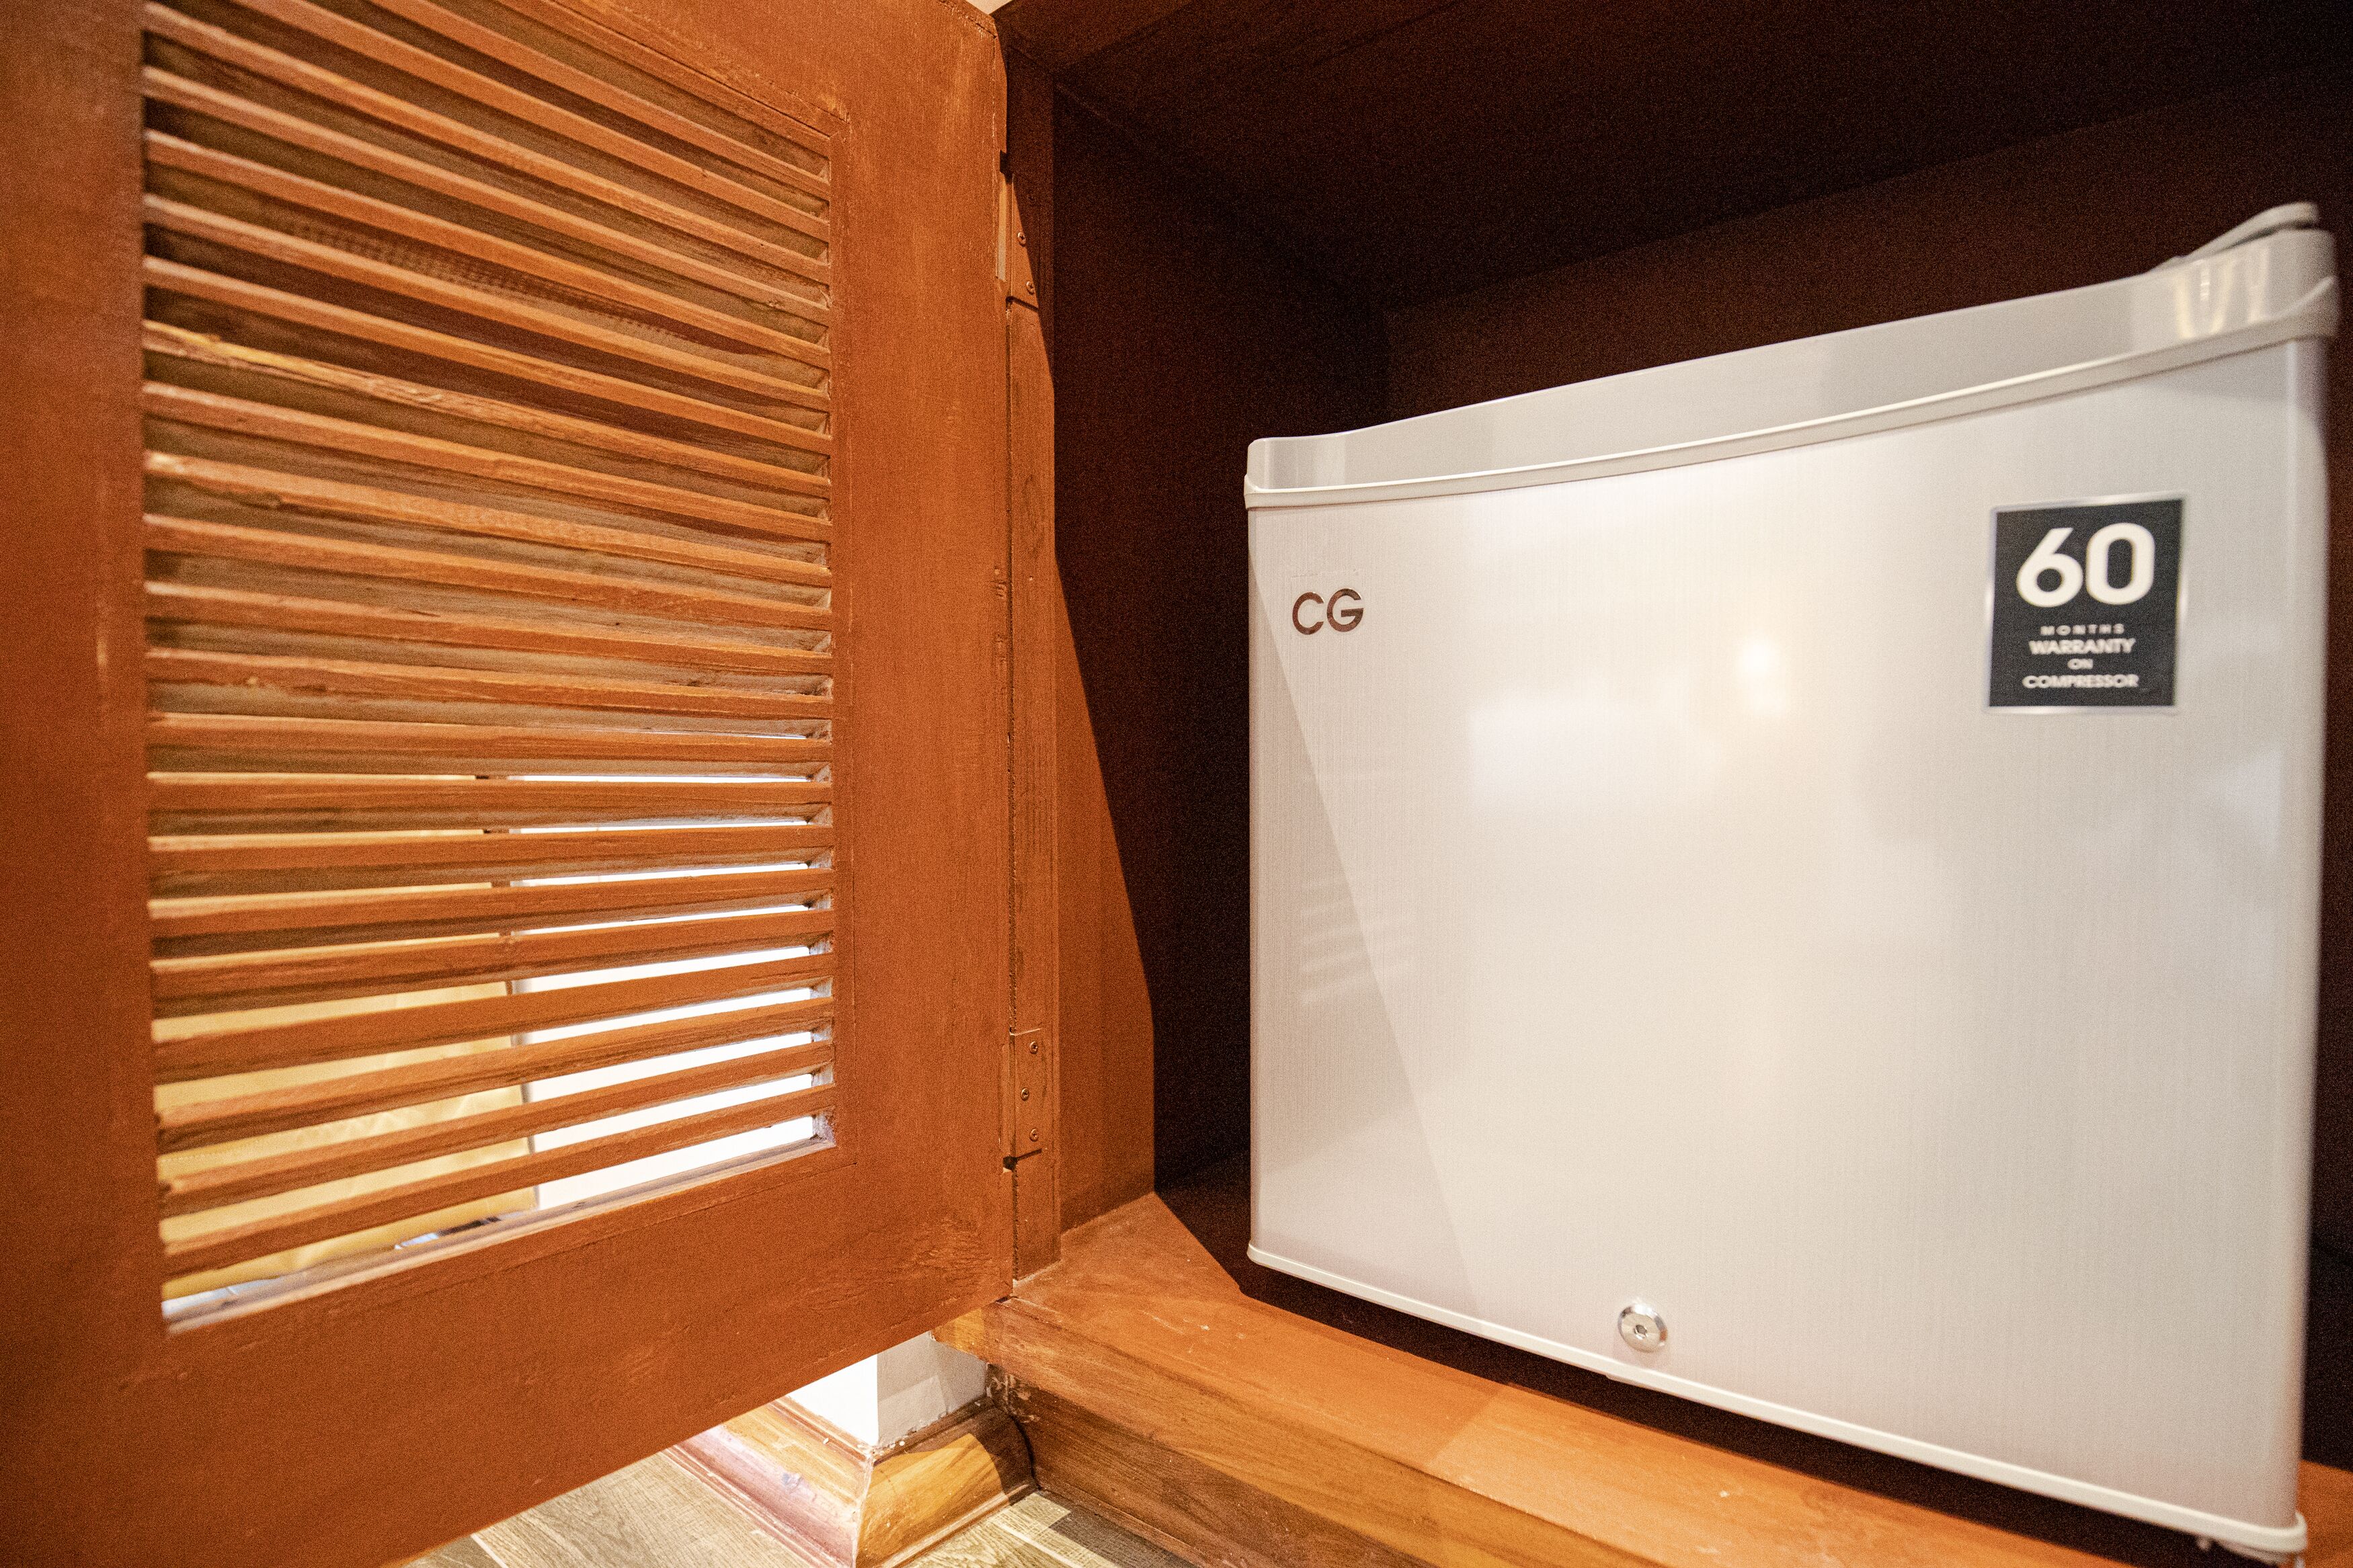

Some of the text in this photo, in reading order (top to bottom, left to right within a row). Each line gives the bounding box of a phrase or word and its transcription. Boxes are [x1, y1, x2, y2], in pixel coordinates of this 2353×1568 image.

[2017, 522, 2155, 608] 60
[1292, 588, 1364, 635] CG
[2040, 624, 2124, 636] MONTHS
[2028, 638, 2137, 655] WARRANTY
[2067, 658, 2093, 670] ON
[2022, 673, 2139, 689] COMPRESSOR
